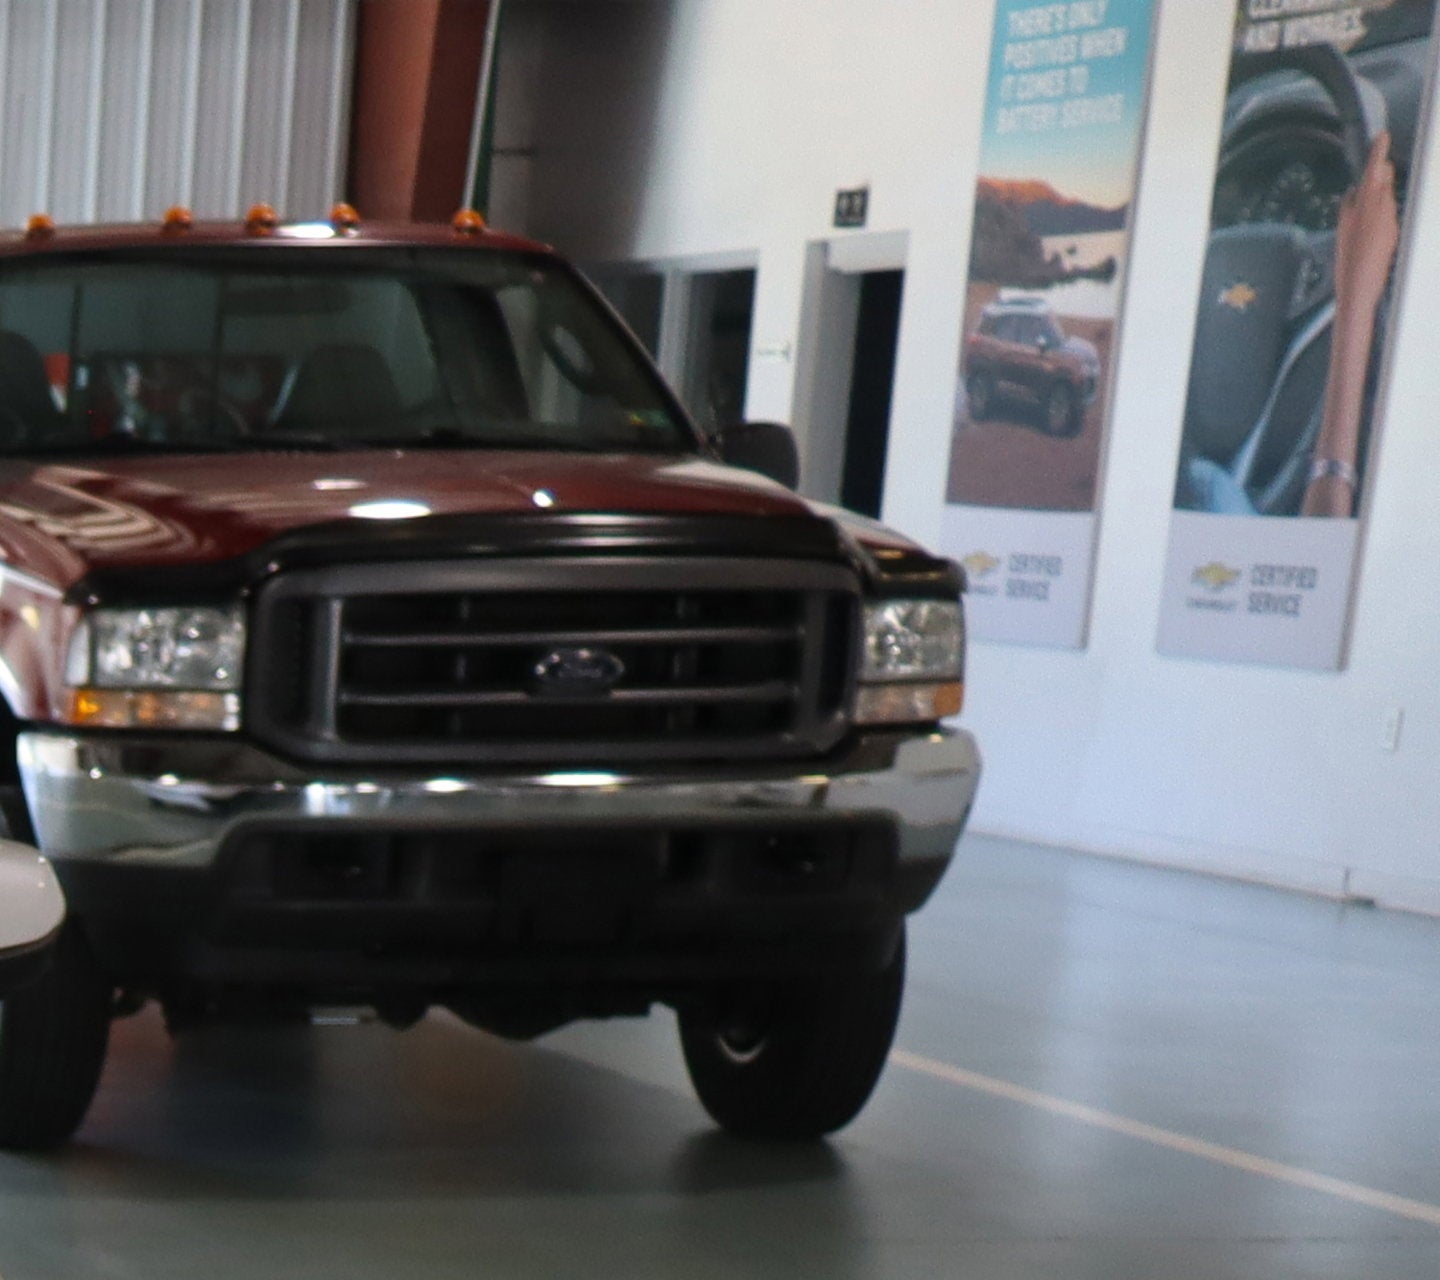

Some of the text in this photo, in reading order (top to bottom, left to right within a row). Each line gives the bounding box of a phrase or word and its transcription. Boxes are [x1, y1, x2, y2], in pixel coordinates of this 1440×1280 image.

[1003, 26, 1127, 69] POSITIVES WHEN
[1000, 74, 1016, 102] IT
[1017, 69, 1068, 100] COMES
[996, 93, 1124, 135] BATTERY SERVICE
[1008, 554, 1063, 576] CERTIFIED
[1249, 563, 1318, 590] CERTIFIED
[1005, 577, 1050, 601] SERVICE
[1246, 591, 1303, 617] SERVICE
